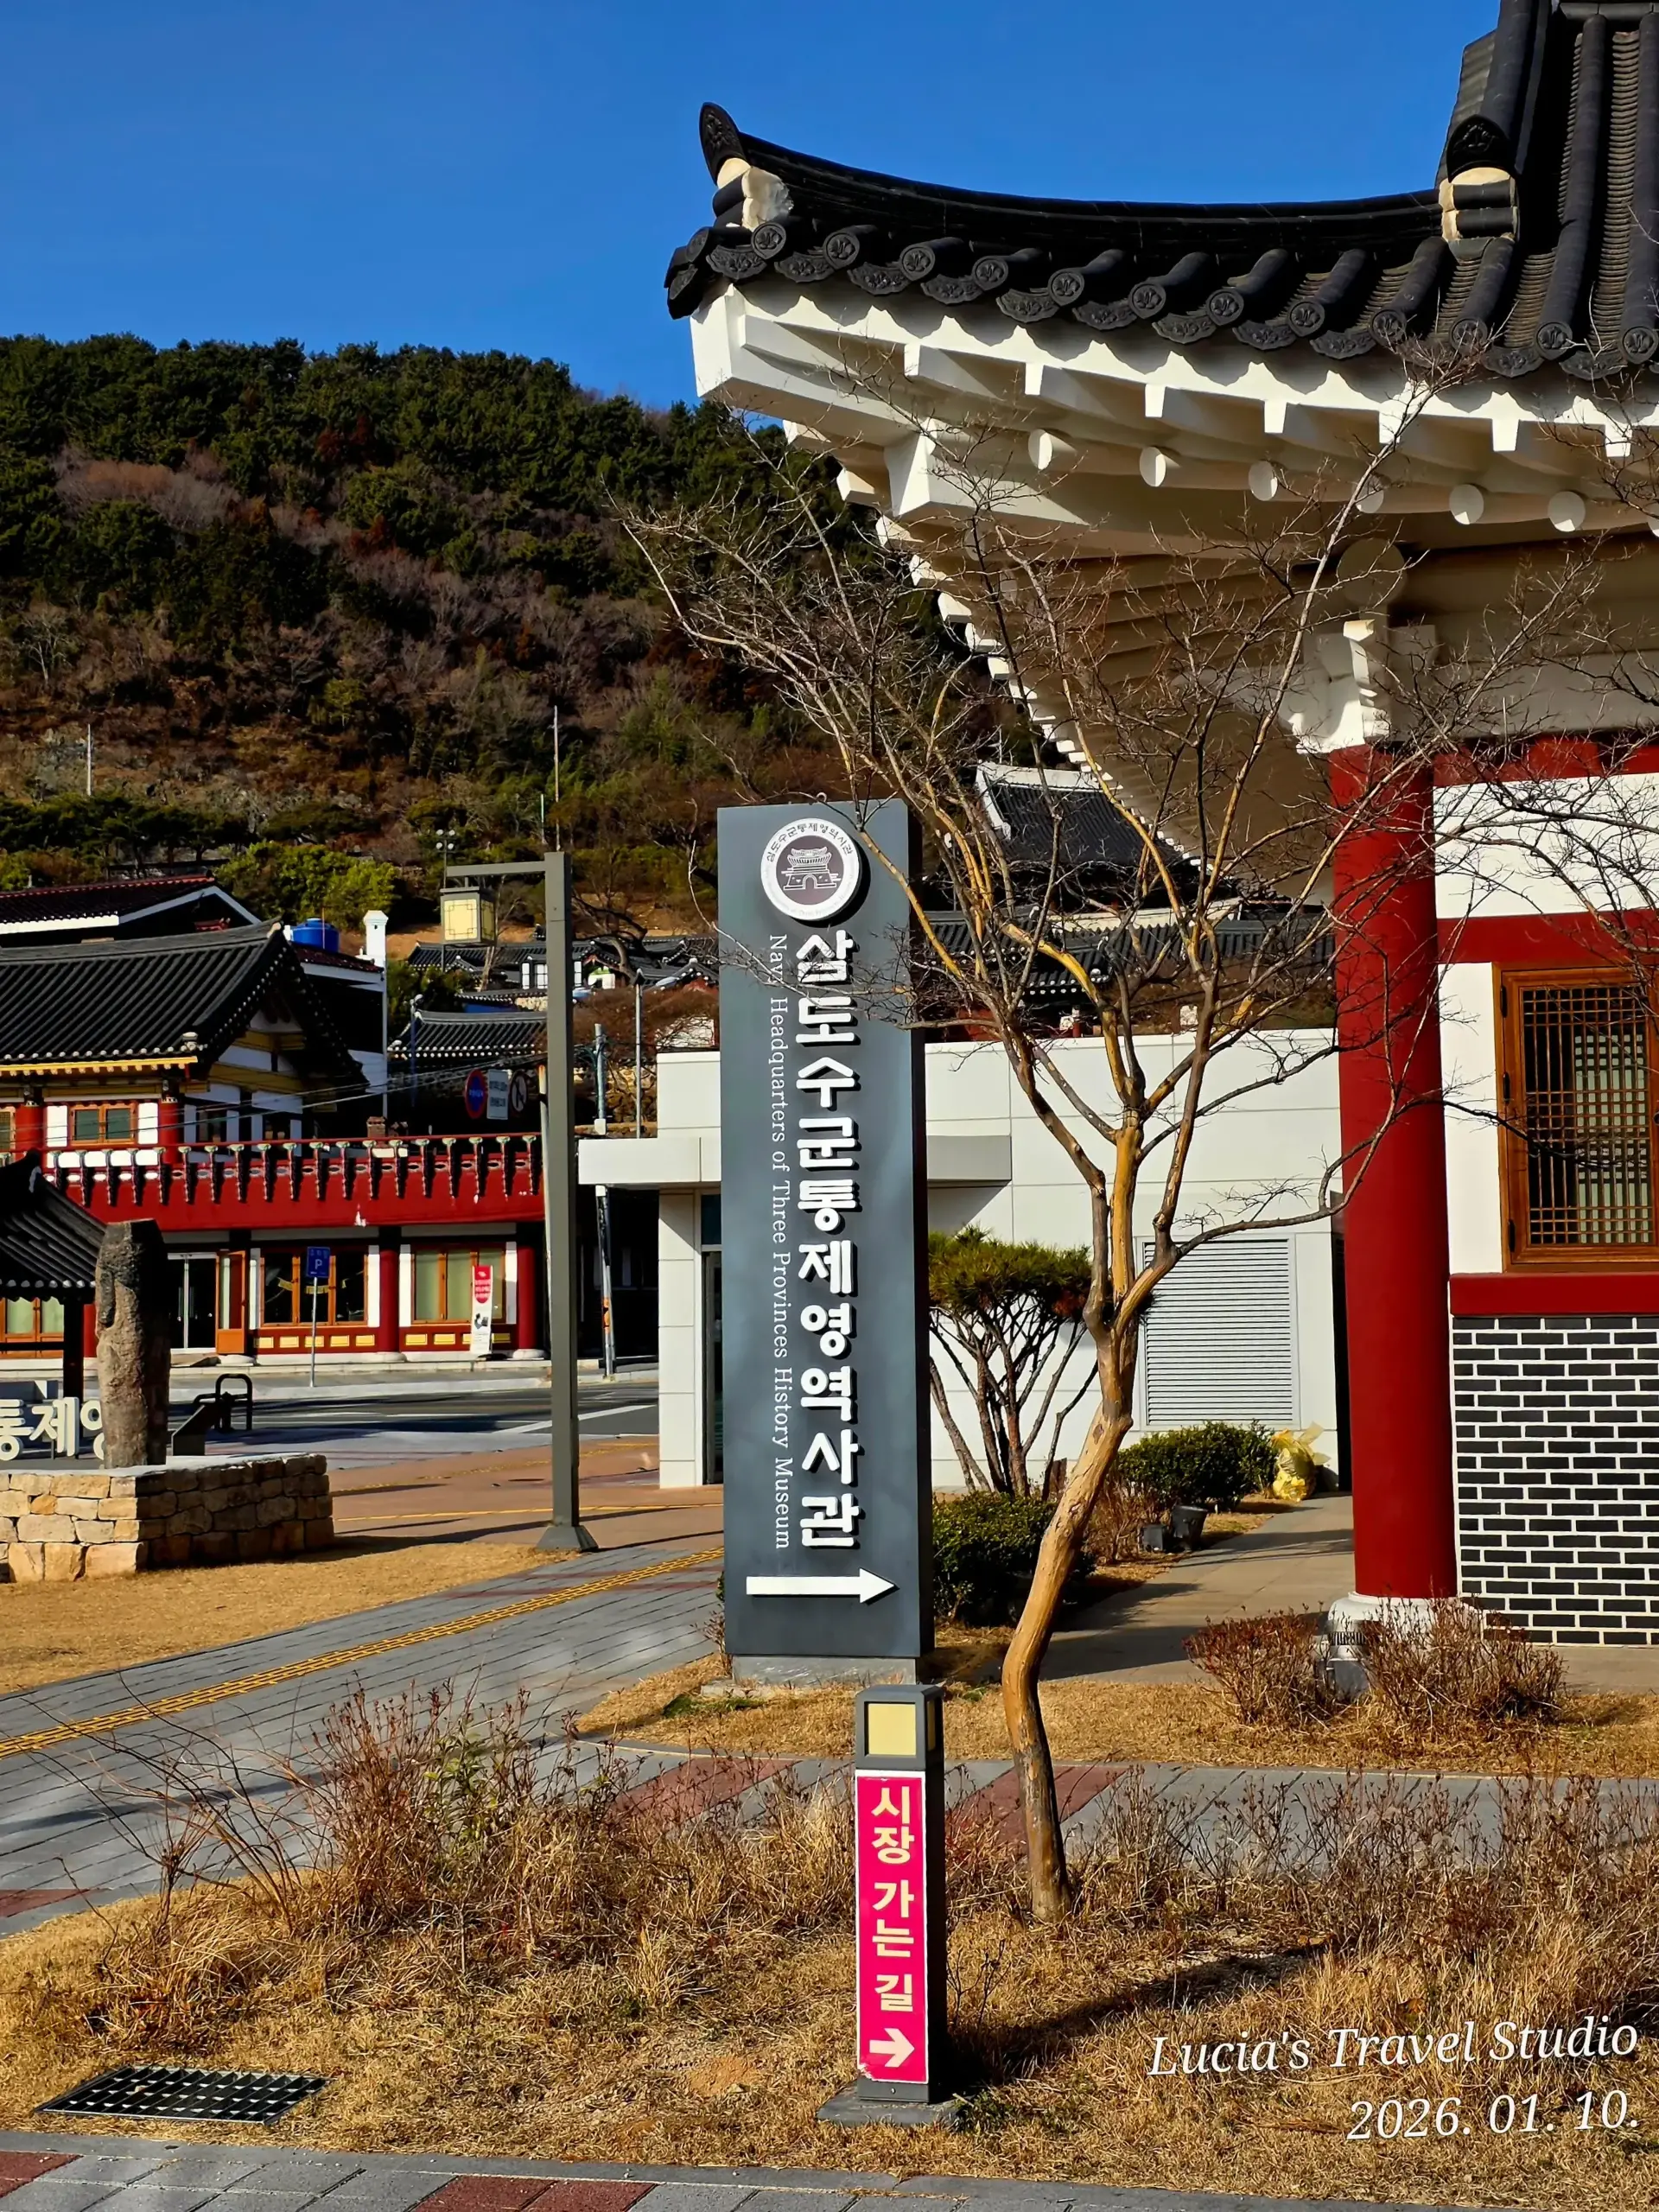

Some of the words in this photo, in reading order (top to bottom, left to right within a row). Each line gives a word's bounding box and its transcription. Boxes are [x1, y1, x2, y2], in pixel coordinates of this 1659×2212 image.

[768, 996, 789, 1142] Headquarters
[772, 1151, 790, 1173] of
[772, 1179, 791, 1244] Three
[796, 929, 860, 1547] 삼도수군통제영역사관
[315, 1258, 323, 1270] P
[772, 1251, 791, 1358] Provinces
[772, 1367, 792, 1449] History
[774, 1457, 793, 1549] Museum
[872, 1785, 914, 1865] 시장
[872, 1879, 915, 1958] 가는
[874, 1974, 913, 2012] 길
